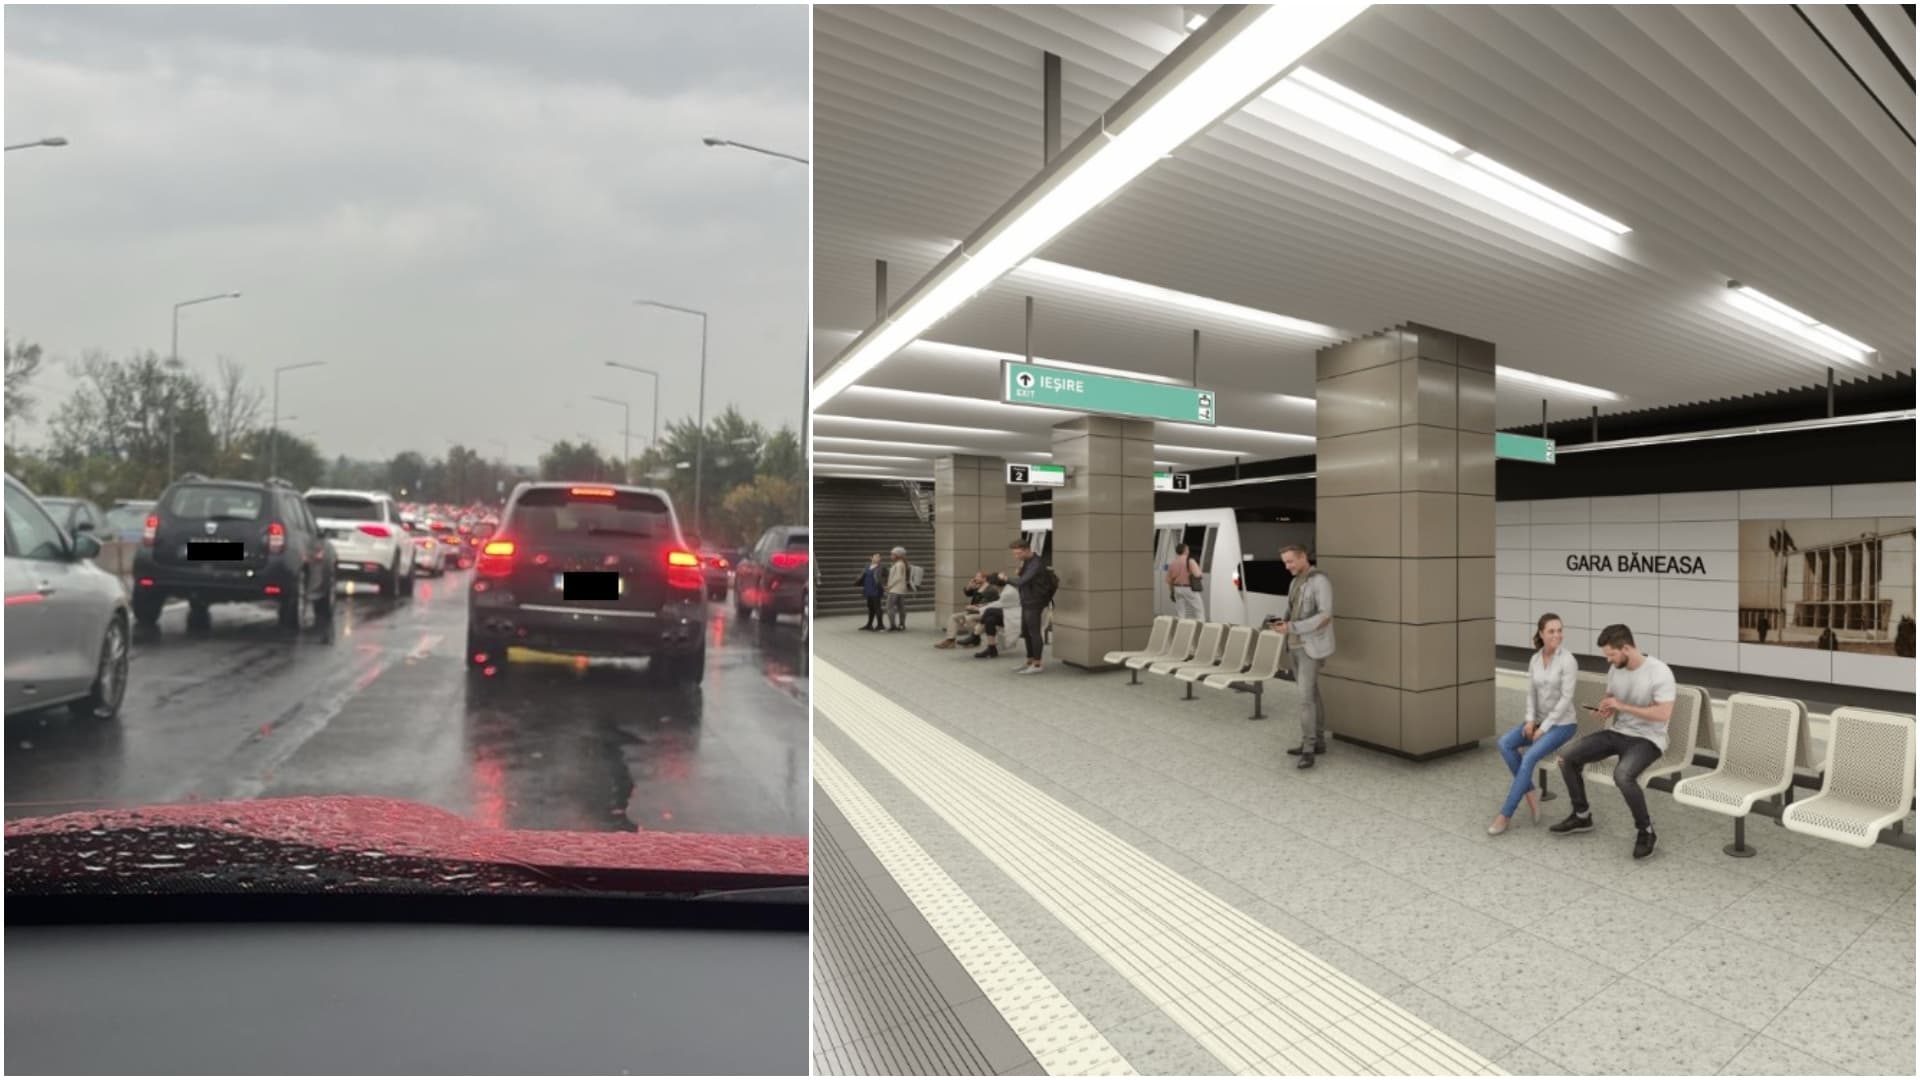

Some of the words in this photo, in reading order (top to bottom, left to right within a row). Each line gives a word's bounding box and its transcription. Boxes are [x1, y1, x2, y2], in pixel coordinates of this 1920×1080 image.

[1040, 375, 1084, 393] IEȘIRE
[1016, 388, 1036, 399] EXIT
[1015, 471, 1024, 481] 2
[1566, 554, 1613, 572] GARA
[1618, 551, 1707, 575] BĂNEASA
